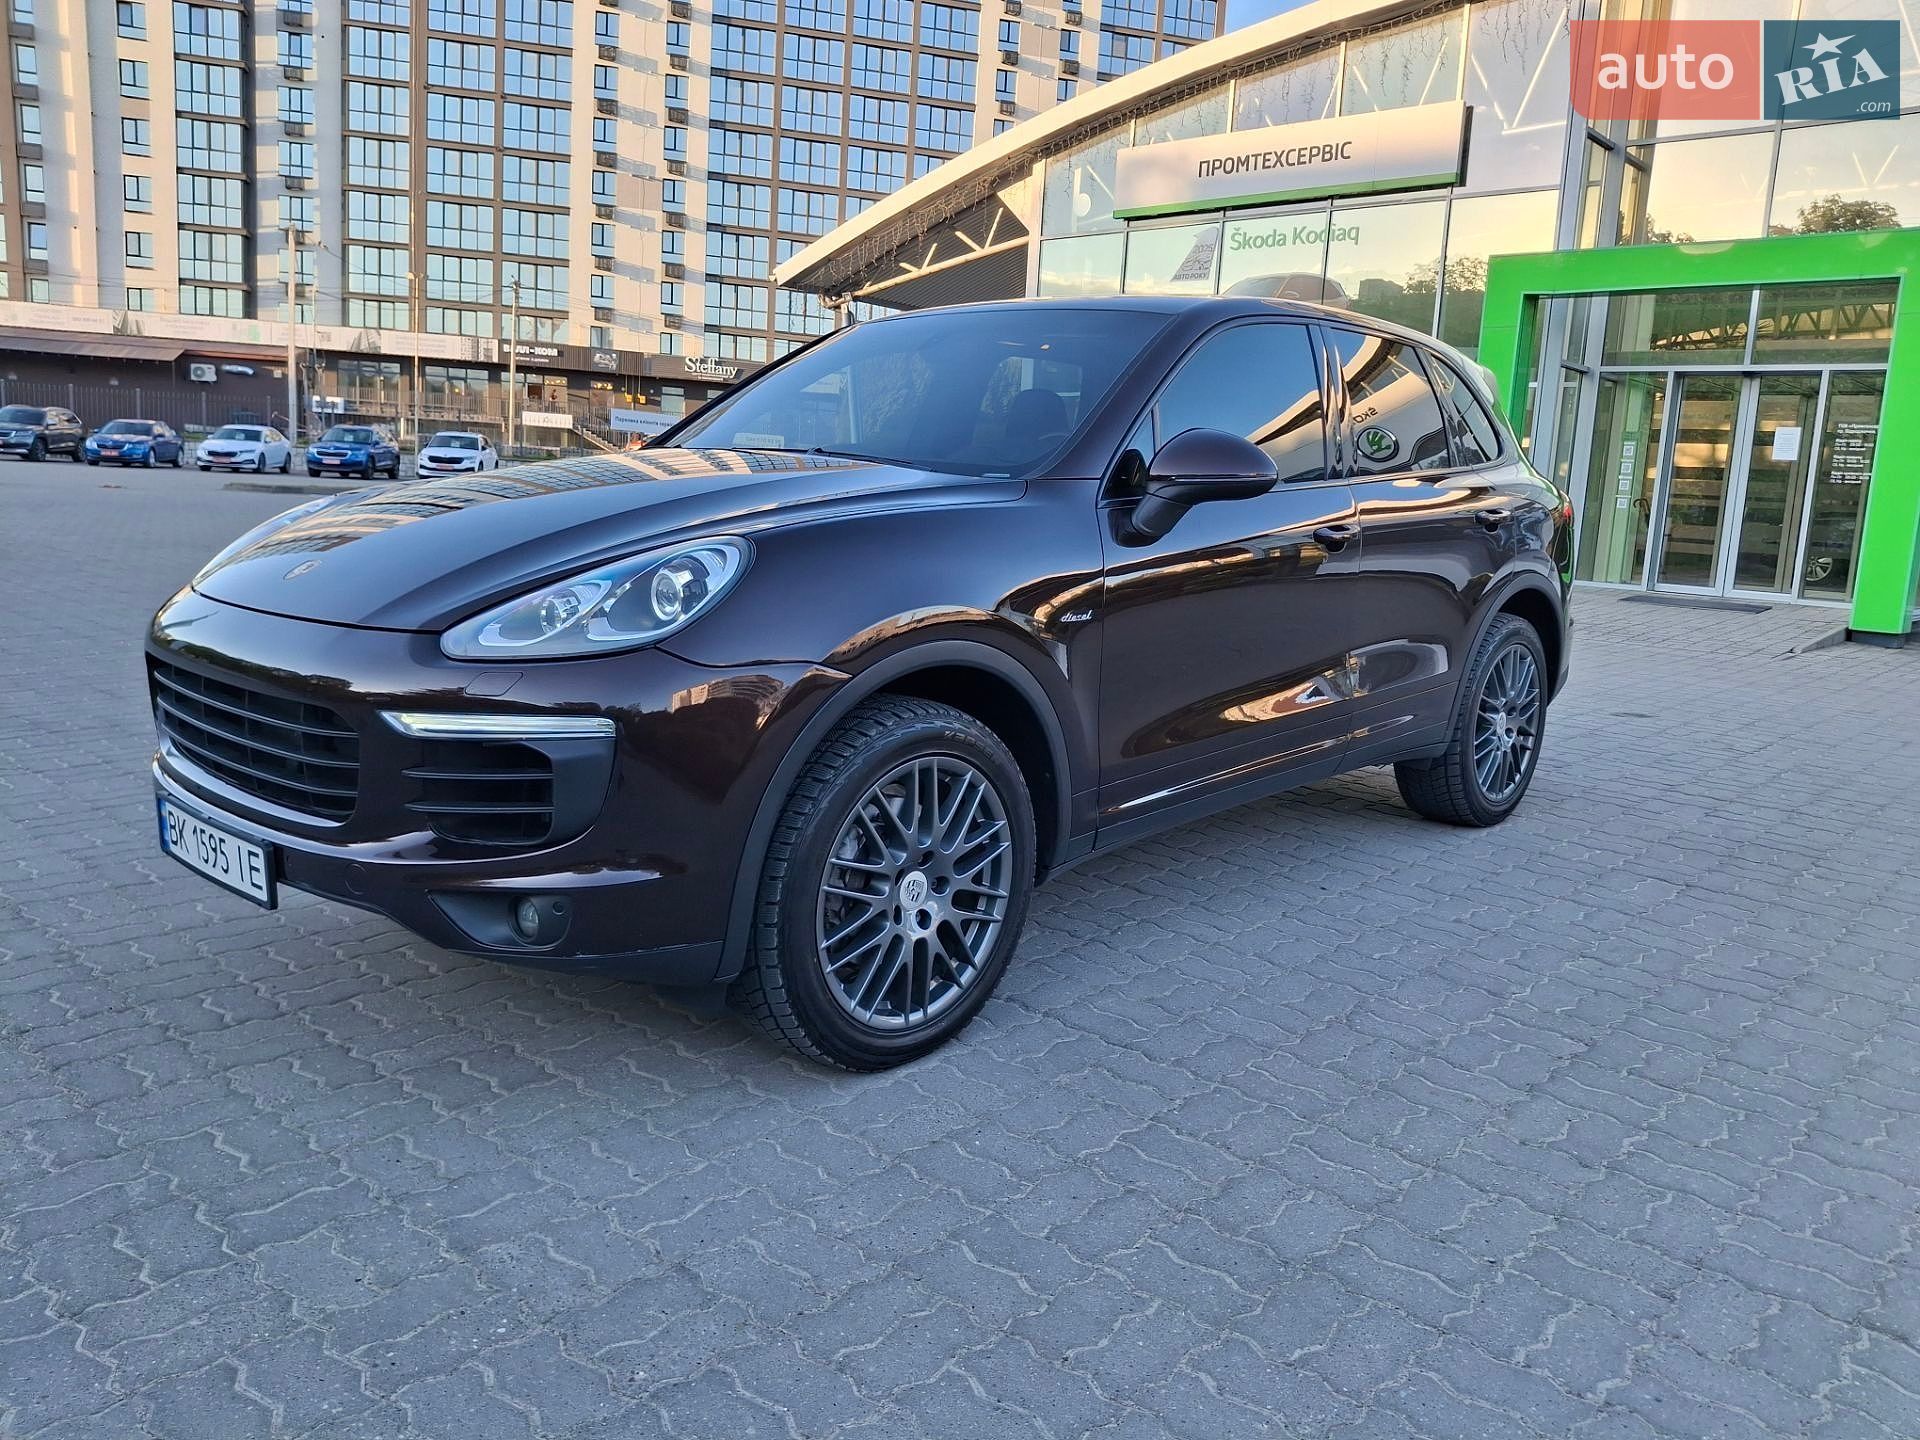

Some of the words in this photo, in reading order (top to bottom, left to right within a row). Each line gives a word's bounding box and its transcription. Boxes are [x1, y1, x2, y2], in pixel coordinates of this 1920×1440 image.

[1198, 141, 1352, 178] ПРОМТЕХСЕРВІС
[1230, 227, 1287, 251] Škoda
[1291, 223, 1360, 246] Kodiaq
[685, 356, 738, 379] Steffany
[1060, 610, 1093, 623] diesel
[168, 810, 189, 854] BK
[192, 825, 230, 874] 1595
[238, 845, 263, 891] IE
